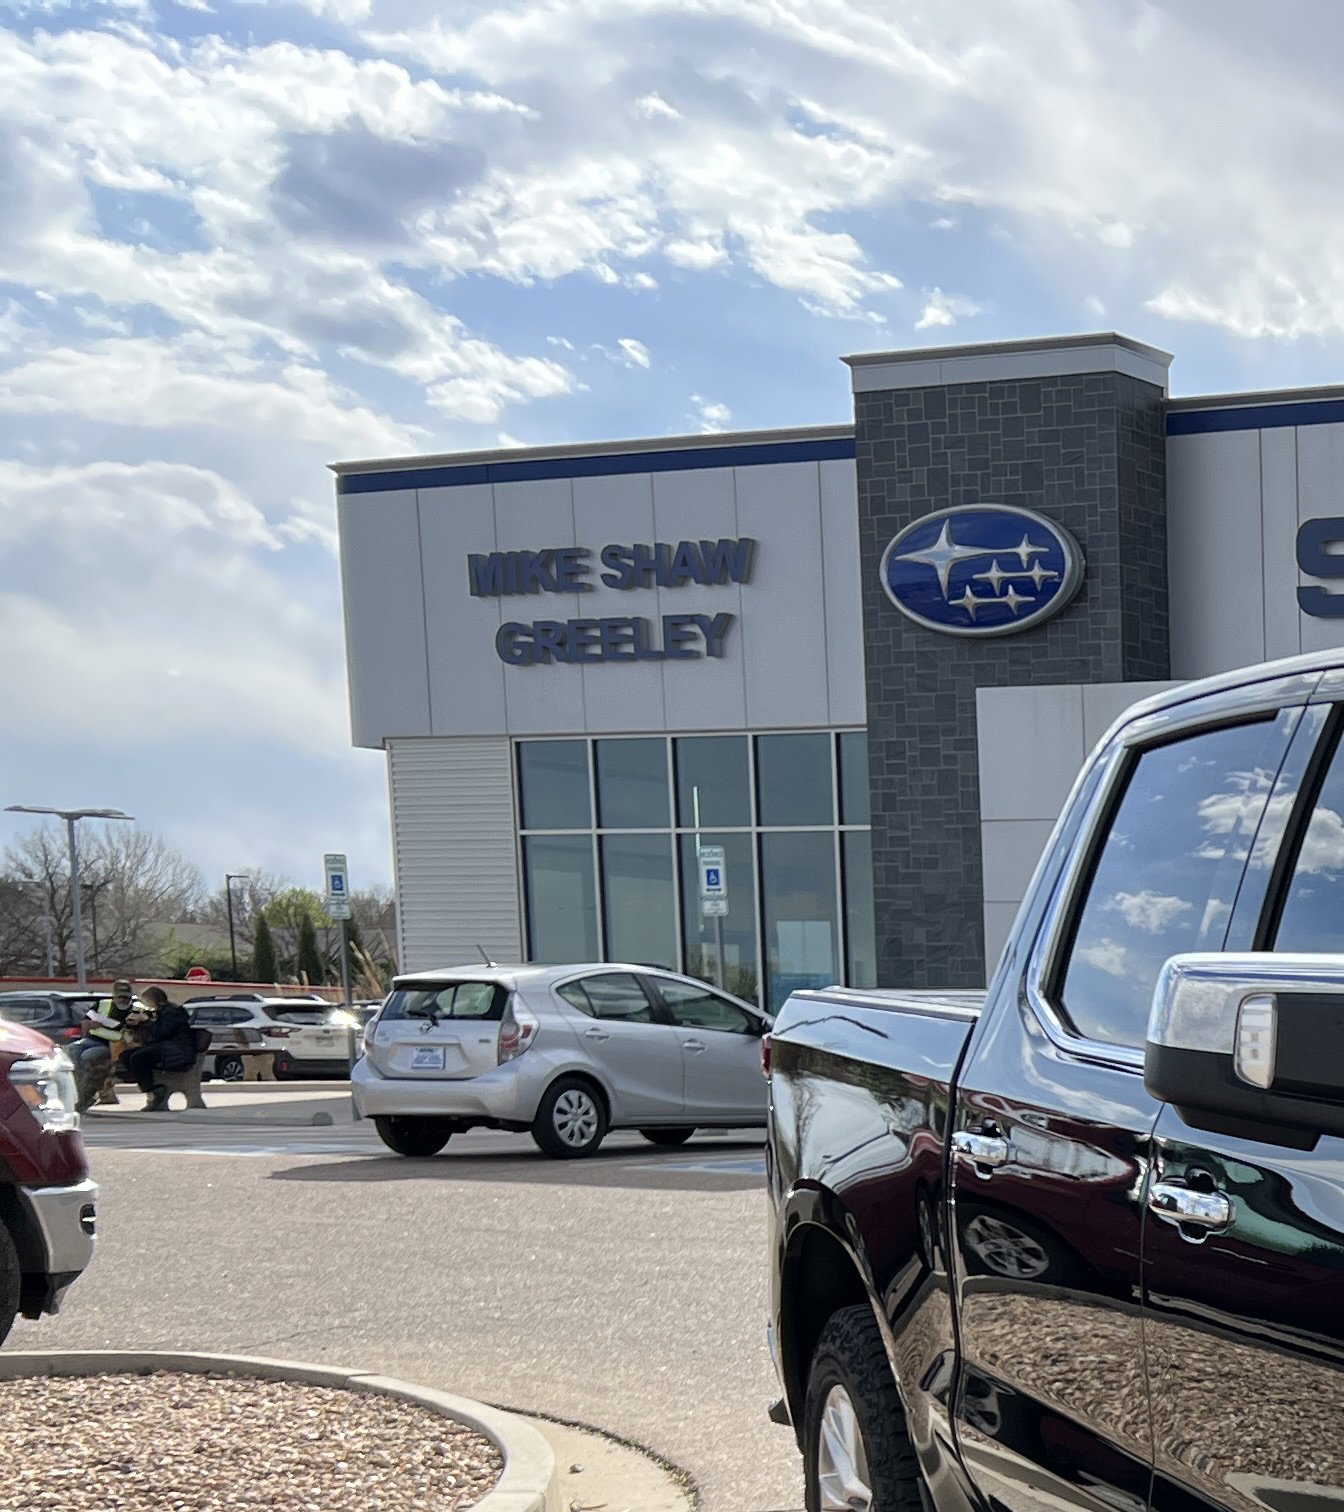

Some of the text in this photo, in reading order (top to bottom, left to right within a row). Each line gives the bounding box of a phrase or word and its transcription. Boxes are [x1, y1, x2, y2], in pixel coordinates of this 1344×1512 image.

[467, 537, 757, 597] MIKE SHAW
[495, 612, 736, 666] GREELEY
